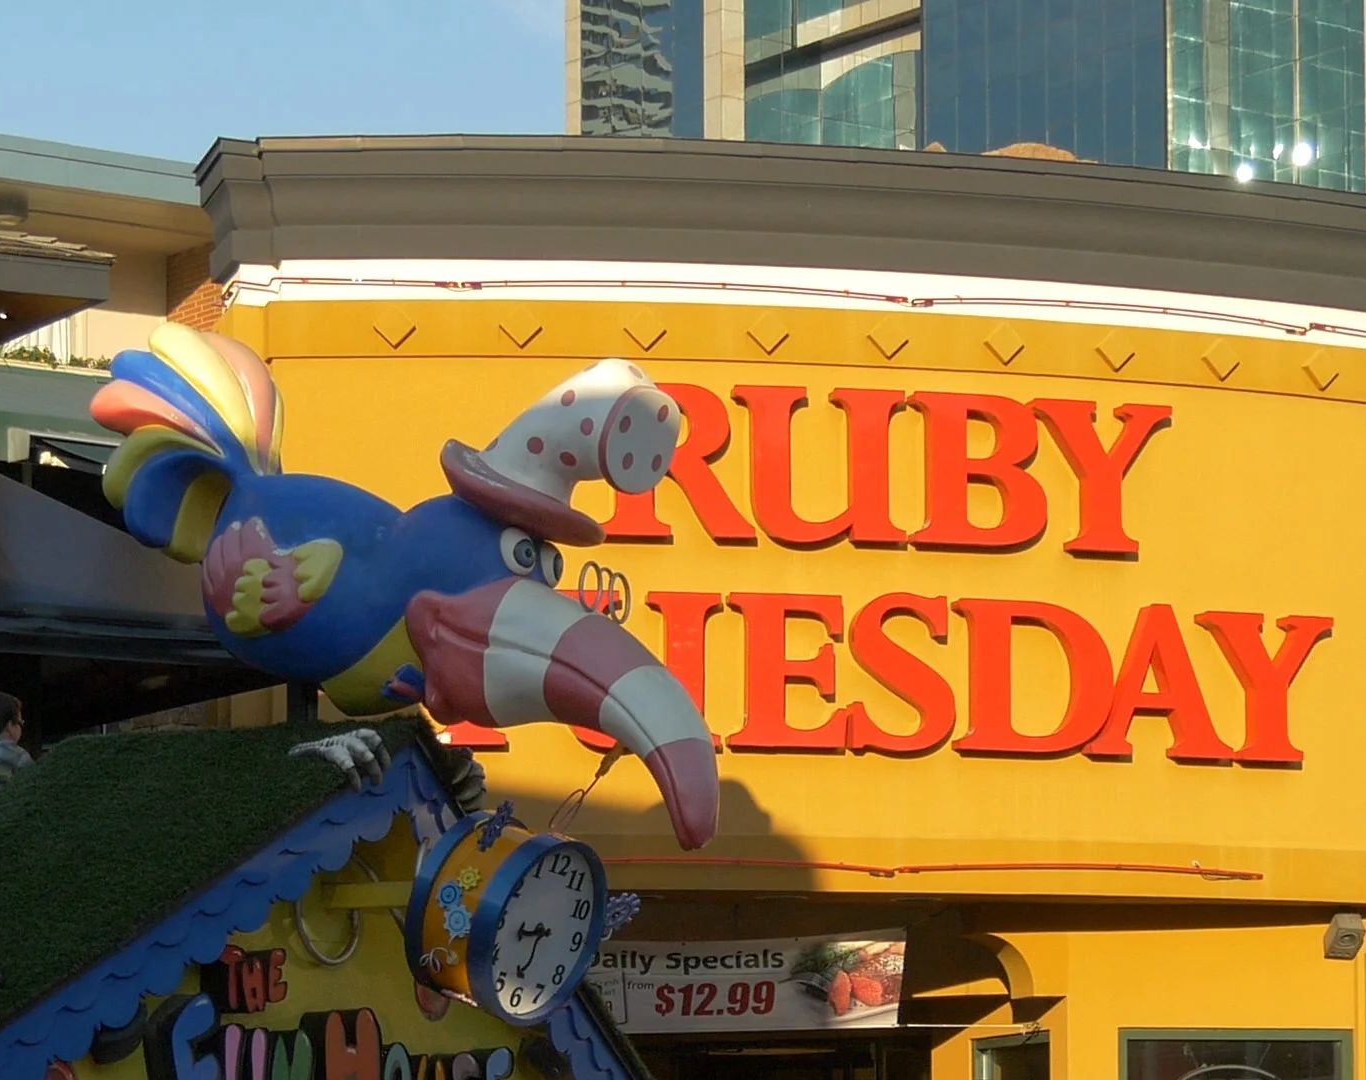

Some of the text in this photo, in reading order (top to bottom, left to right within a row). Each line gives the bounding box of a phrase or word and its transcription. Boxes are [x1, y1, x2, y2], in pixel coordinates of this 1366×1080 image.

[606, 383, 1172, 555] RUBY
[444, 590, 1333, 763] UESDAY
[548, 852, 571, 877] 12
[566, 870, 586, 892] 11
[570, 898, 591, 920] 10
[569, 932, 584, 952] 9
[665, 948, 785, 975] Specials
[552, 965, 566, 985] 8
[626, 980, 655, 991] from
[510, 987, 523, 1007] 6
[654, 980, 776, 1017] $12.99
